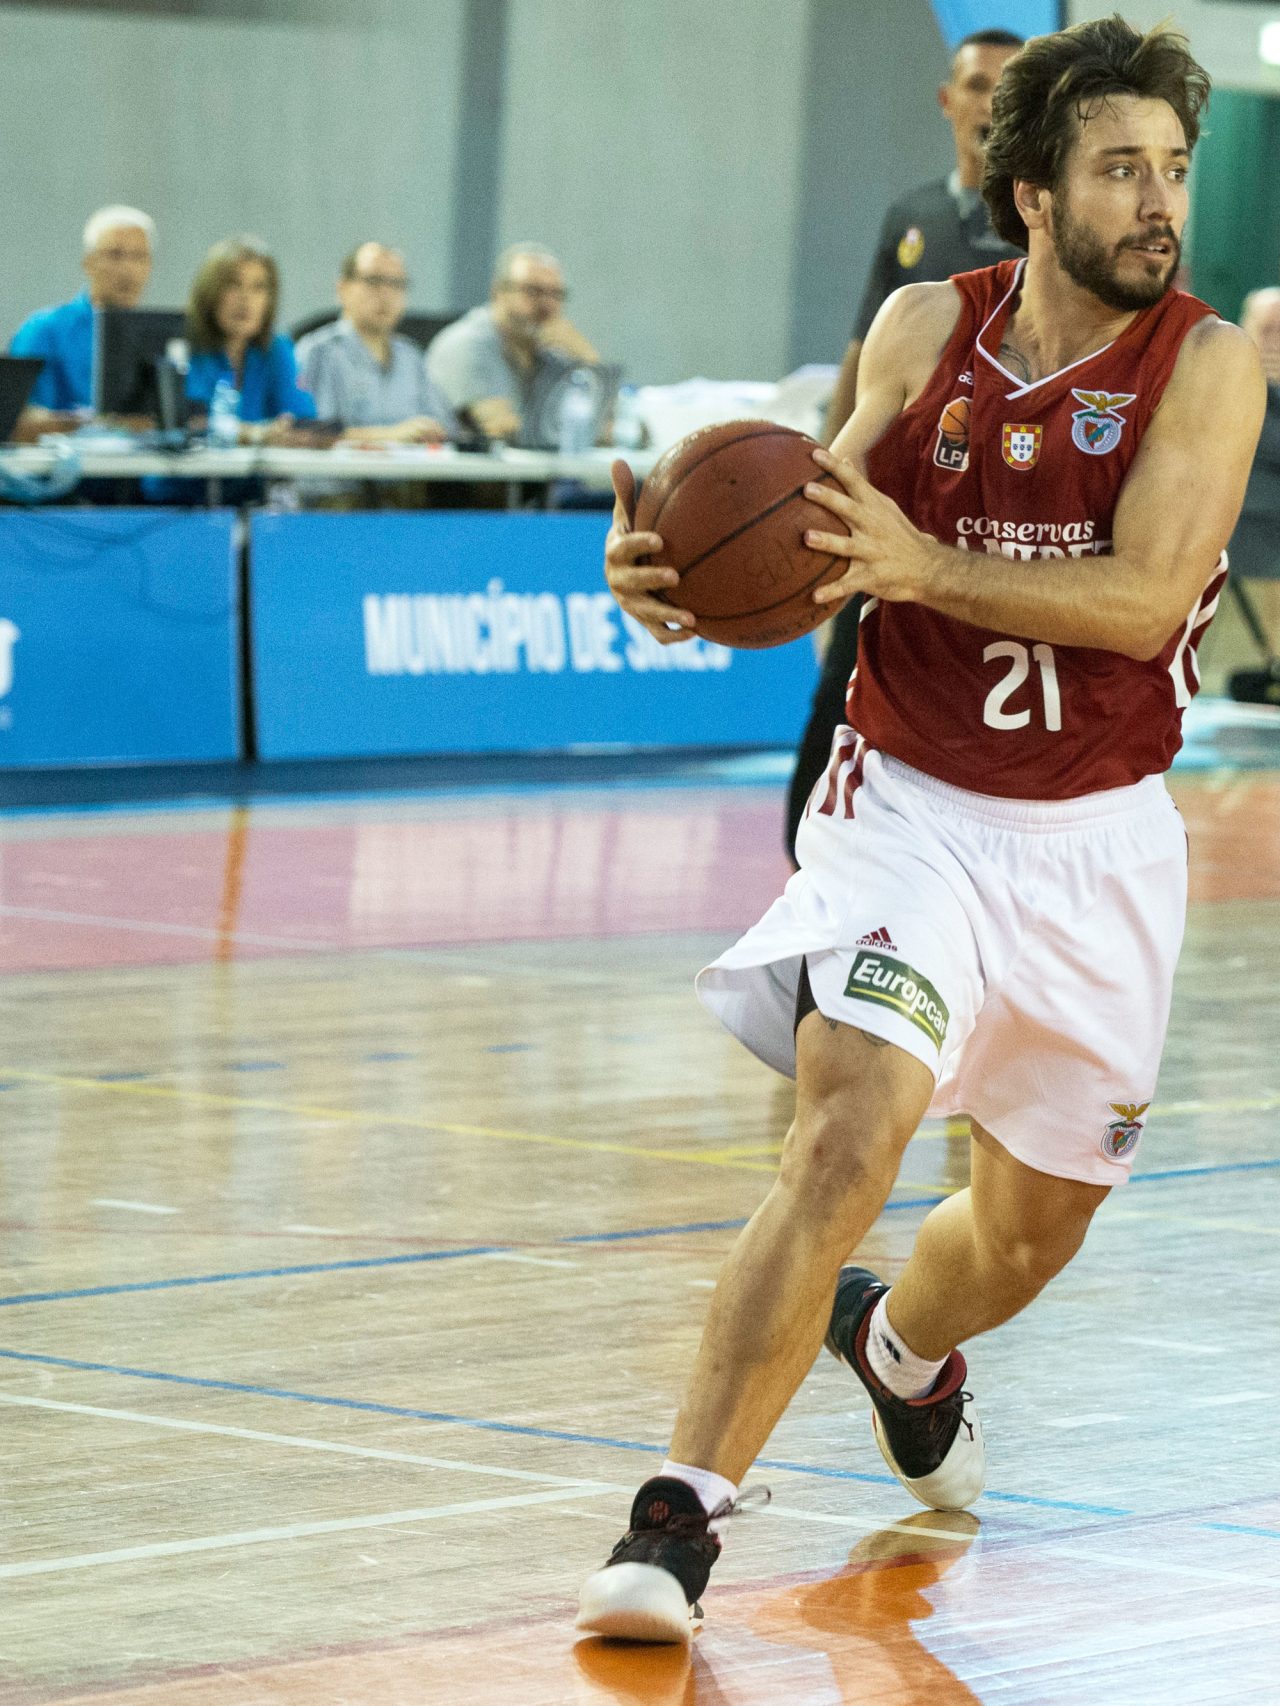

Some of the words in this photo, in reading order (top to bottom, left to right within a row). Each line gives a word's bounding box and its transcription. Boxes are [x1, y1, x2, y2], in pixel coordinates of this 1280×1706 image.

[363, 577, 567, 674] MUNICÍPIO
[566, 592, 623, 673] DE
[983, 640, 1062, 732] 21
[856, 939, 897, 952] adidas
